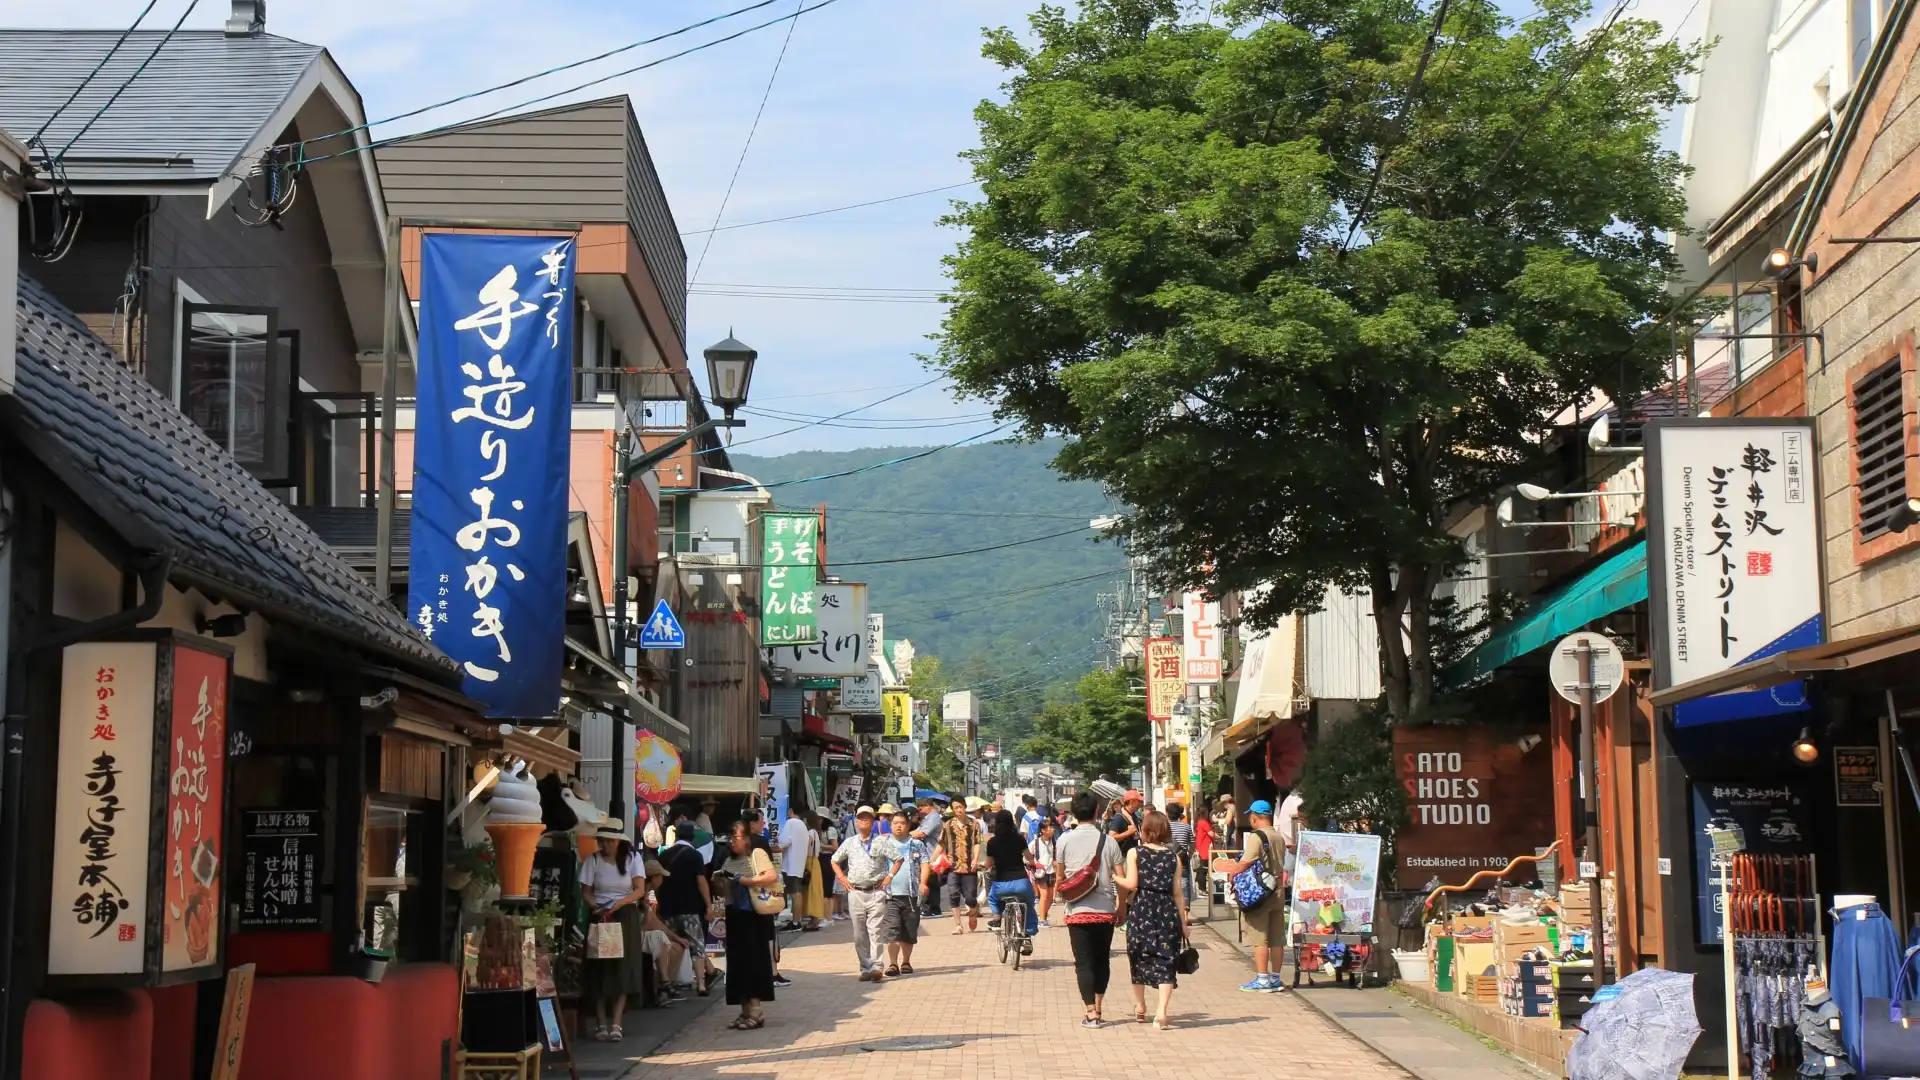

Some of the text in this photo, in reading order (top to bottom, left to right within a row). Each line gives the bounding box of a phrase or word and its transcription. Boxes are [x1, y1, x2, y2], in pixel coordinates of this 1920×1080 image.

[451, 264, 539, 682] 手造りおかき
[1683, 466, 1693, 499] Denim
[1740, 442, 1785, 537] 軽井沢
[1786, 436, 1800, 500] デニム専門店
[765, 541, 788, 615] うどん
[789, 541, 814, 615] そば
[1686, 546, 1694, 570] store
[1702, 465, 1738, 660] デニムストリート
[436, 573, 450, 624] おかき処
[821, 593, 841, 609] 処
[1673, 526, 1688, 663] KARUIZAWA DENIM STREET
[767, 624, 811, 641] にし川
[1152, 655, 1181, 680] 酒
[89, 666, 117, 741] おかき処
[1403, 752, 1462, 773] SATO
[1404, 777, 1480, 799] SHOES
[255, 813, 310, 827] 長野名物
[1407, 803, 1491, 825] STUDIO
[262, 856, 281, 918] せんべい
[281, 838, 299, 905] 信州味噌
[1406, 857, 1509, 868] Established in 1903
